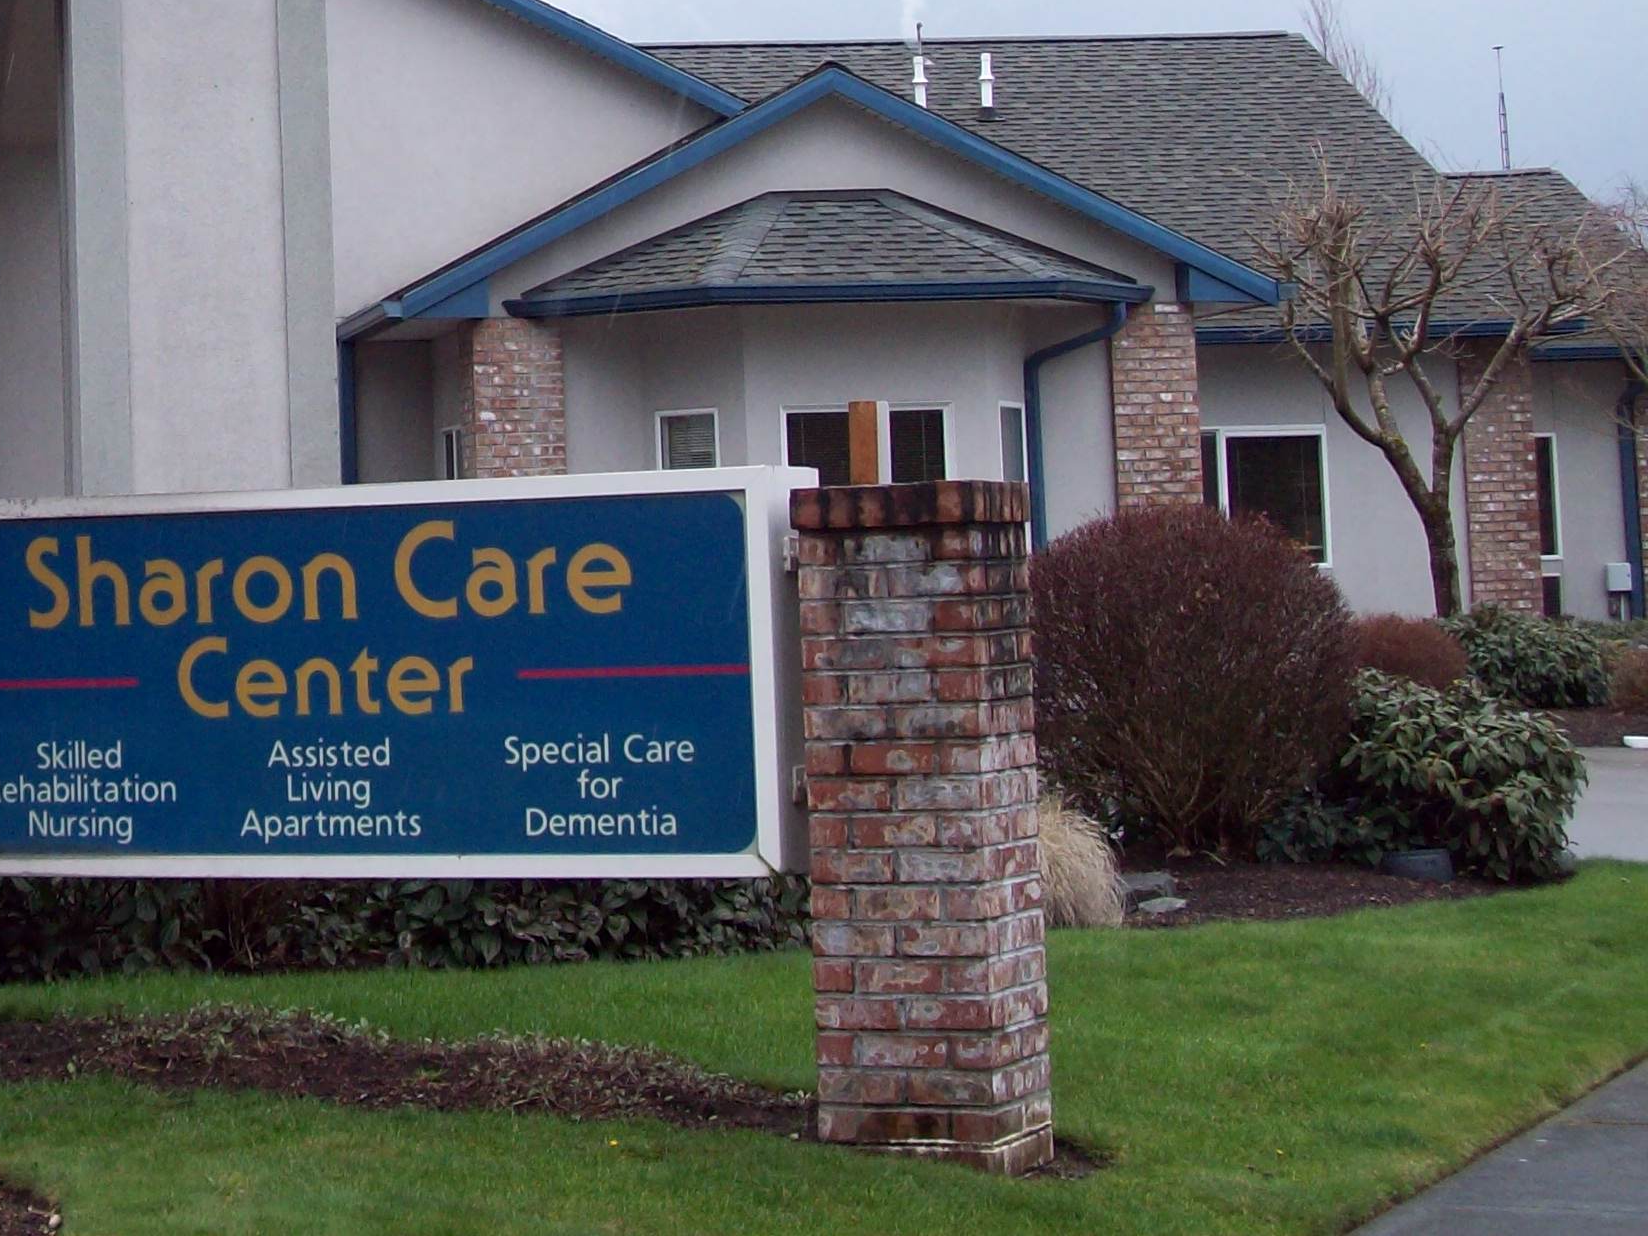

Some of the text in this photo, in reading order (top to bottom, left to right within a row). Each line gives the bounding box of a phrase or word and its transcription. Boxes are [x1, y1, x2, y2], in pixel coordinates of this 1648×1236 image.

[26, 520, 632, 628] Sharon Care
[177, 636, 474, 718] Center
[37, 740, 122, 769] Skilled
[267, 737, 390, 768] Assisted
[504, 733, 695, 772] Special Care
[287, 774, 371, 809] Living
[576, 768, 623, 799] for
[28, 810, 133, 845] Nursing
[240, 809, 422, 844] Apartments
[526, 807, 677, 837] Dementia
